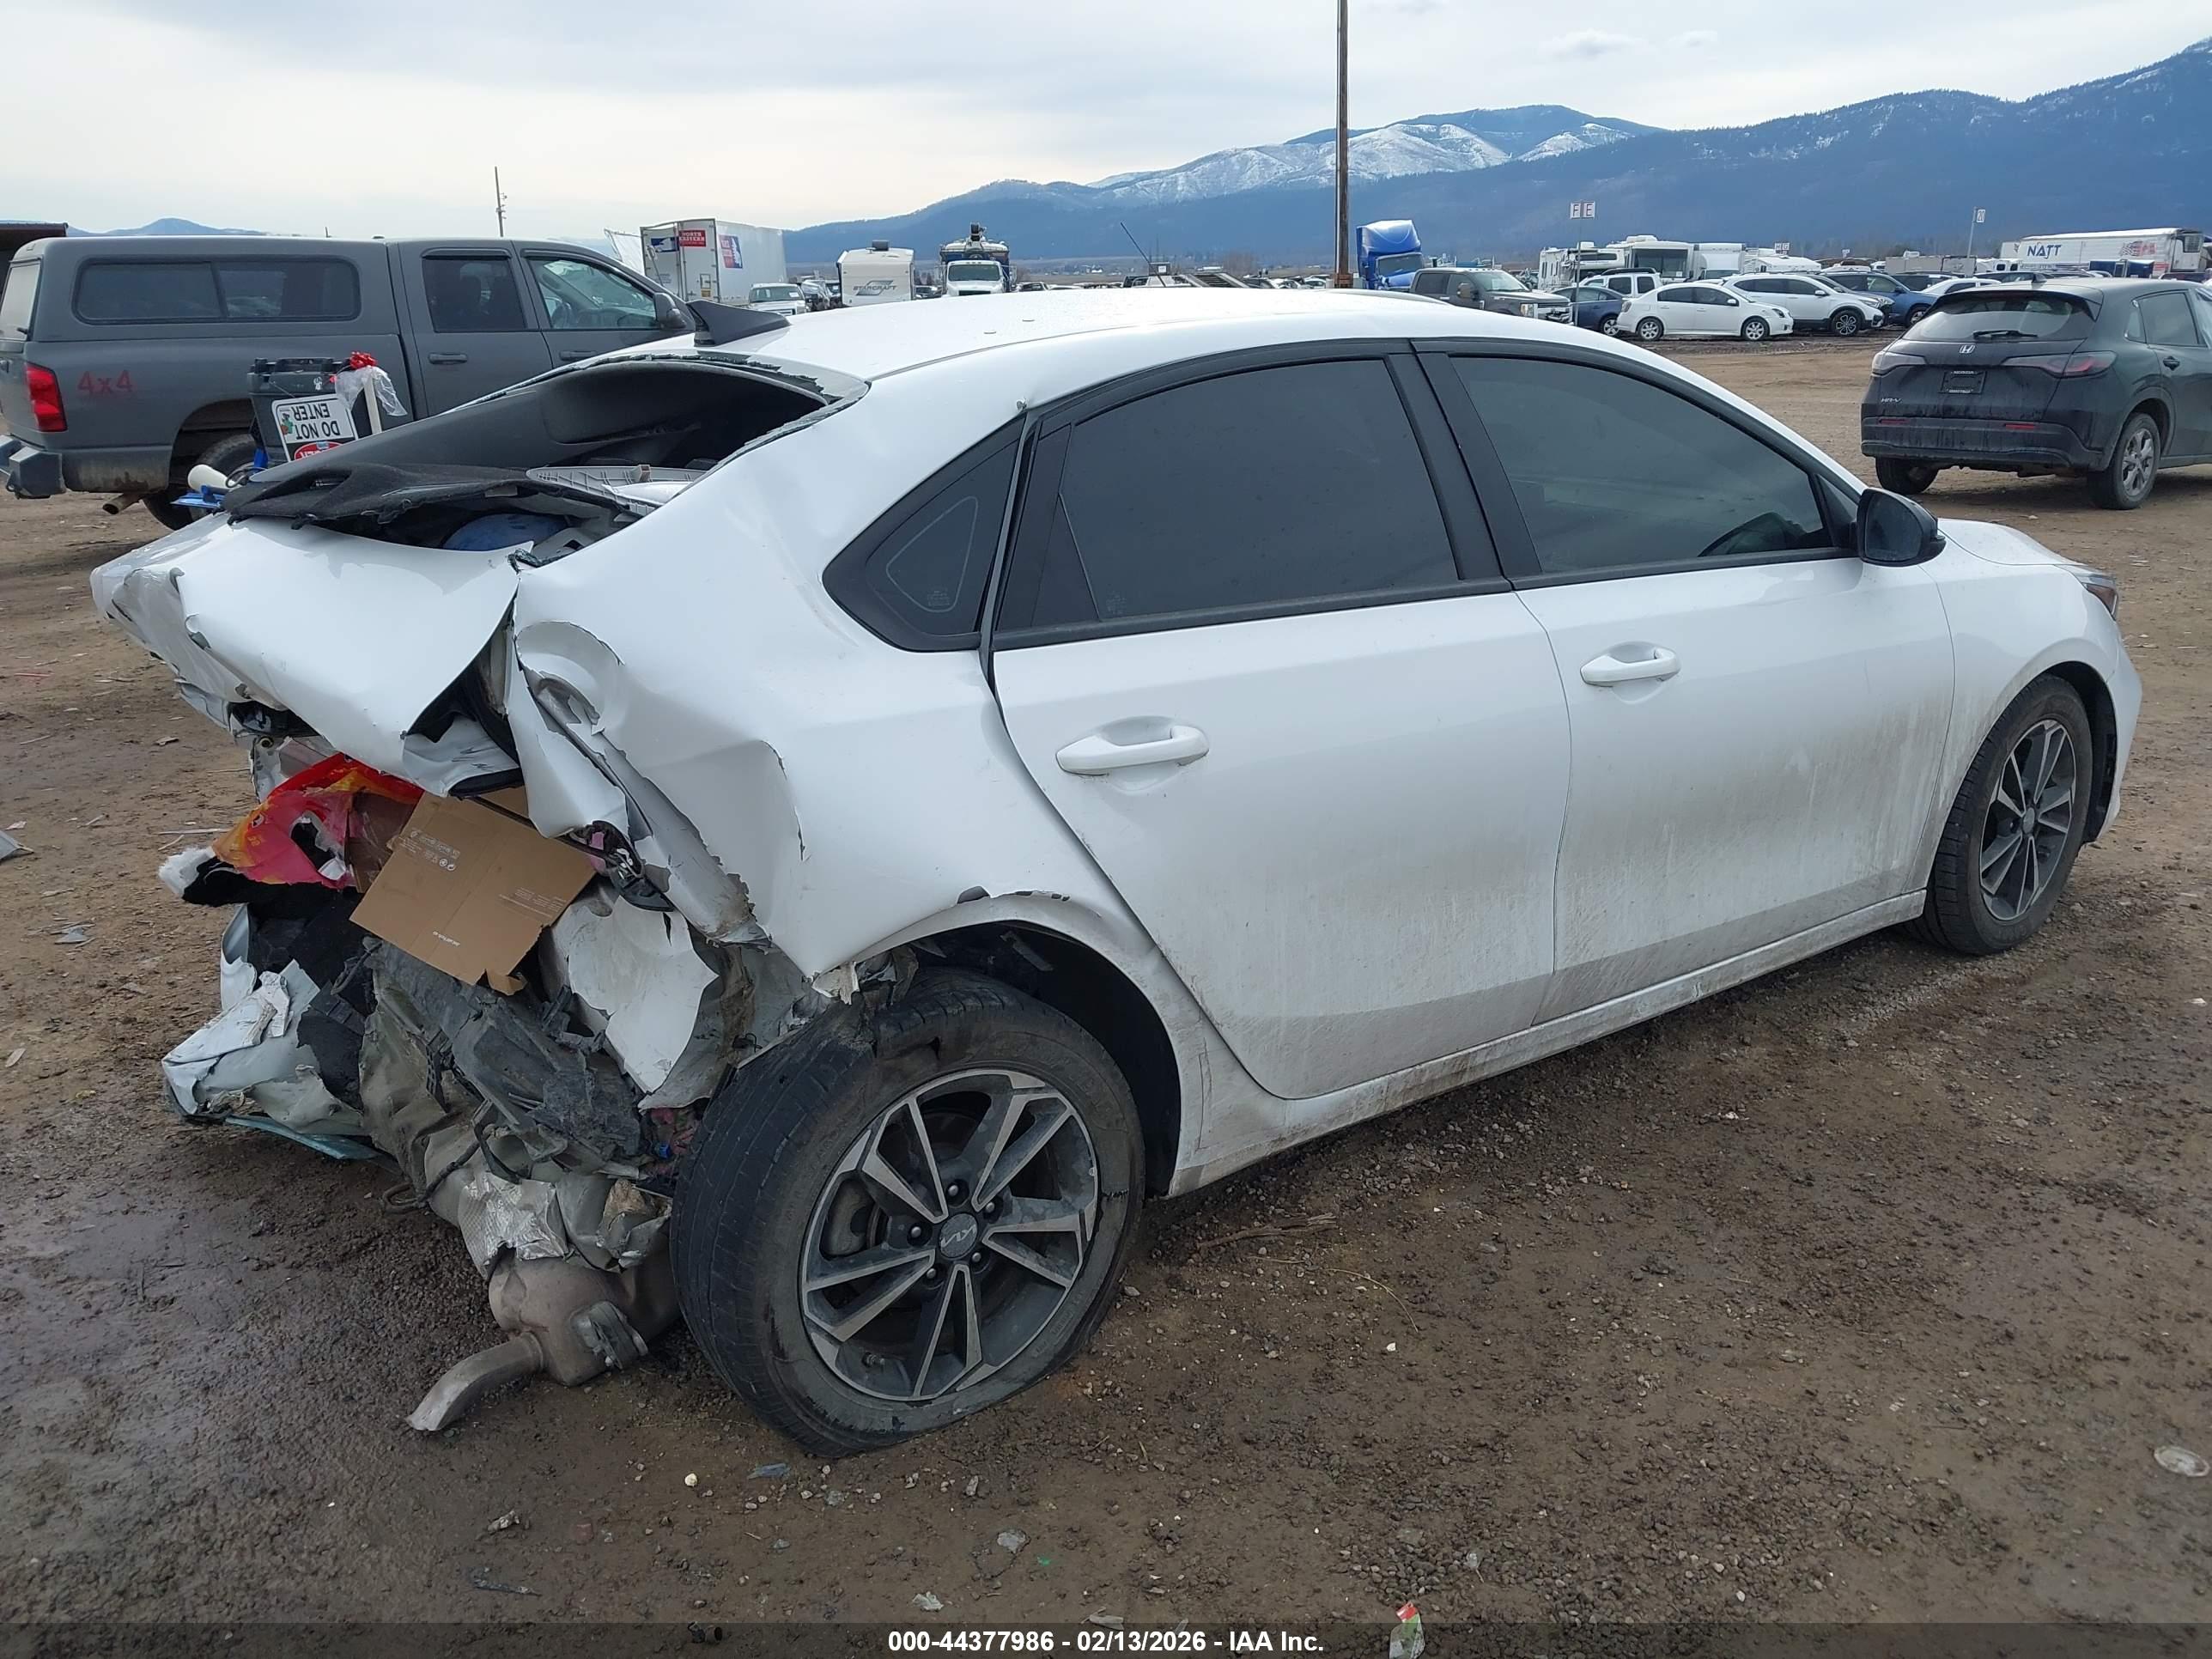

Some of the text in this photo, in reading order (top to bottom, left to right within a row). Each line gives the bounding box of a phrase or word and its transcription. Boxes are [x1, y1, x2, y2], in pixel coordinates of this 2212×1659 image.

[1572, 204, 1580, 216] F
[1586, 203, 1593, 216] E
[2027, 244, 2062, 259] NATT
[77, 370, 134, 393] 4x4
[291, 403, 331, 421] ENTER
[295, 420, 341, 440] DO NOT
